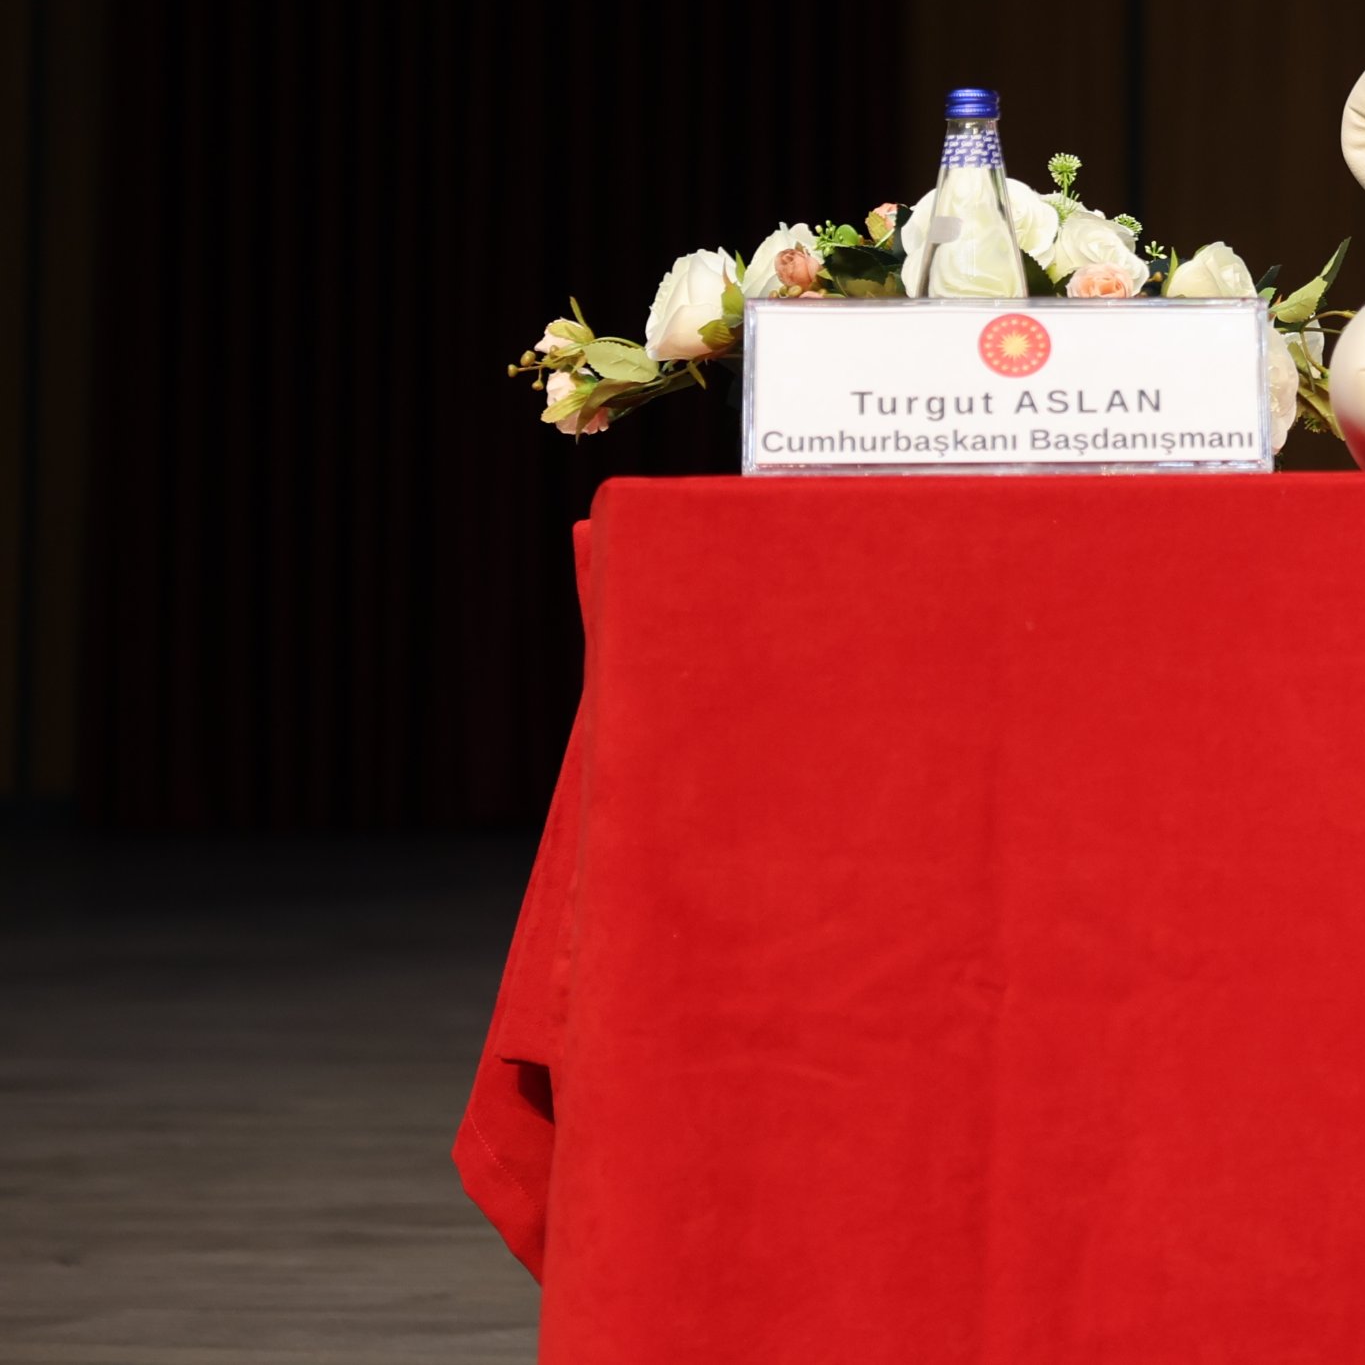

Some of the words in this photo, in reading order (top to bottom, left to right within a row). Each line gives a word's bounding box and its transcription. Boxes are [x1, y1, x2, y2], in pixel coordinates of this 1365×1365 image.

[850, 391, 994, 421] Turgut
[1015, 389, 1162, 414] ASLAN
[761, 429, 1017, 457] Cumhurbaşkanı
[1030, 428, 1255, 456] Başdanışmanı
